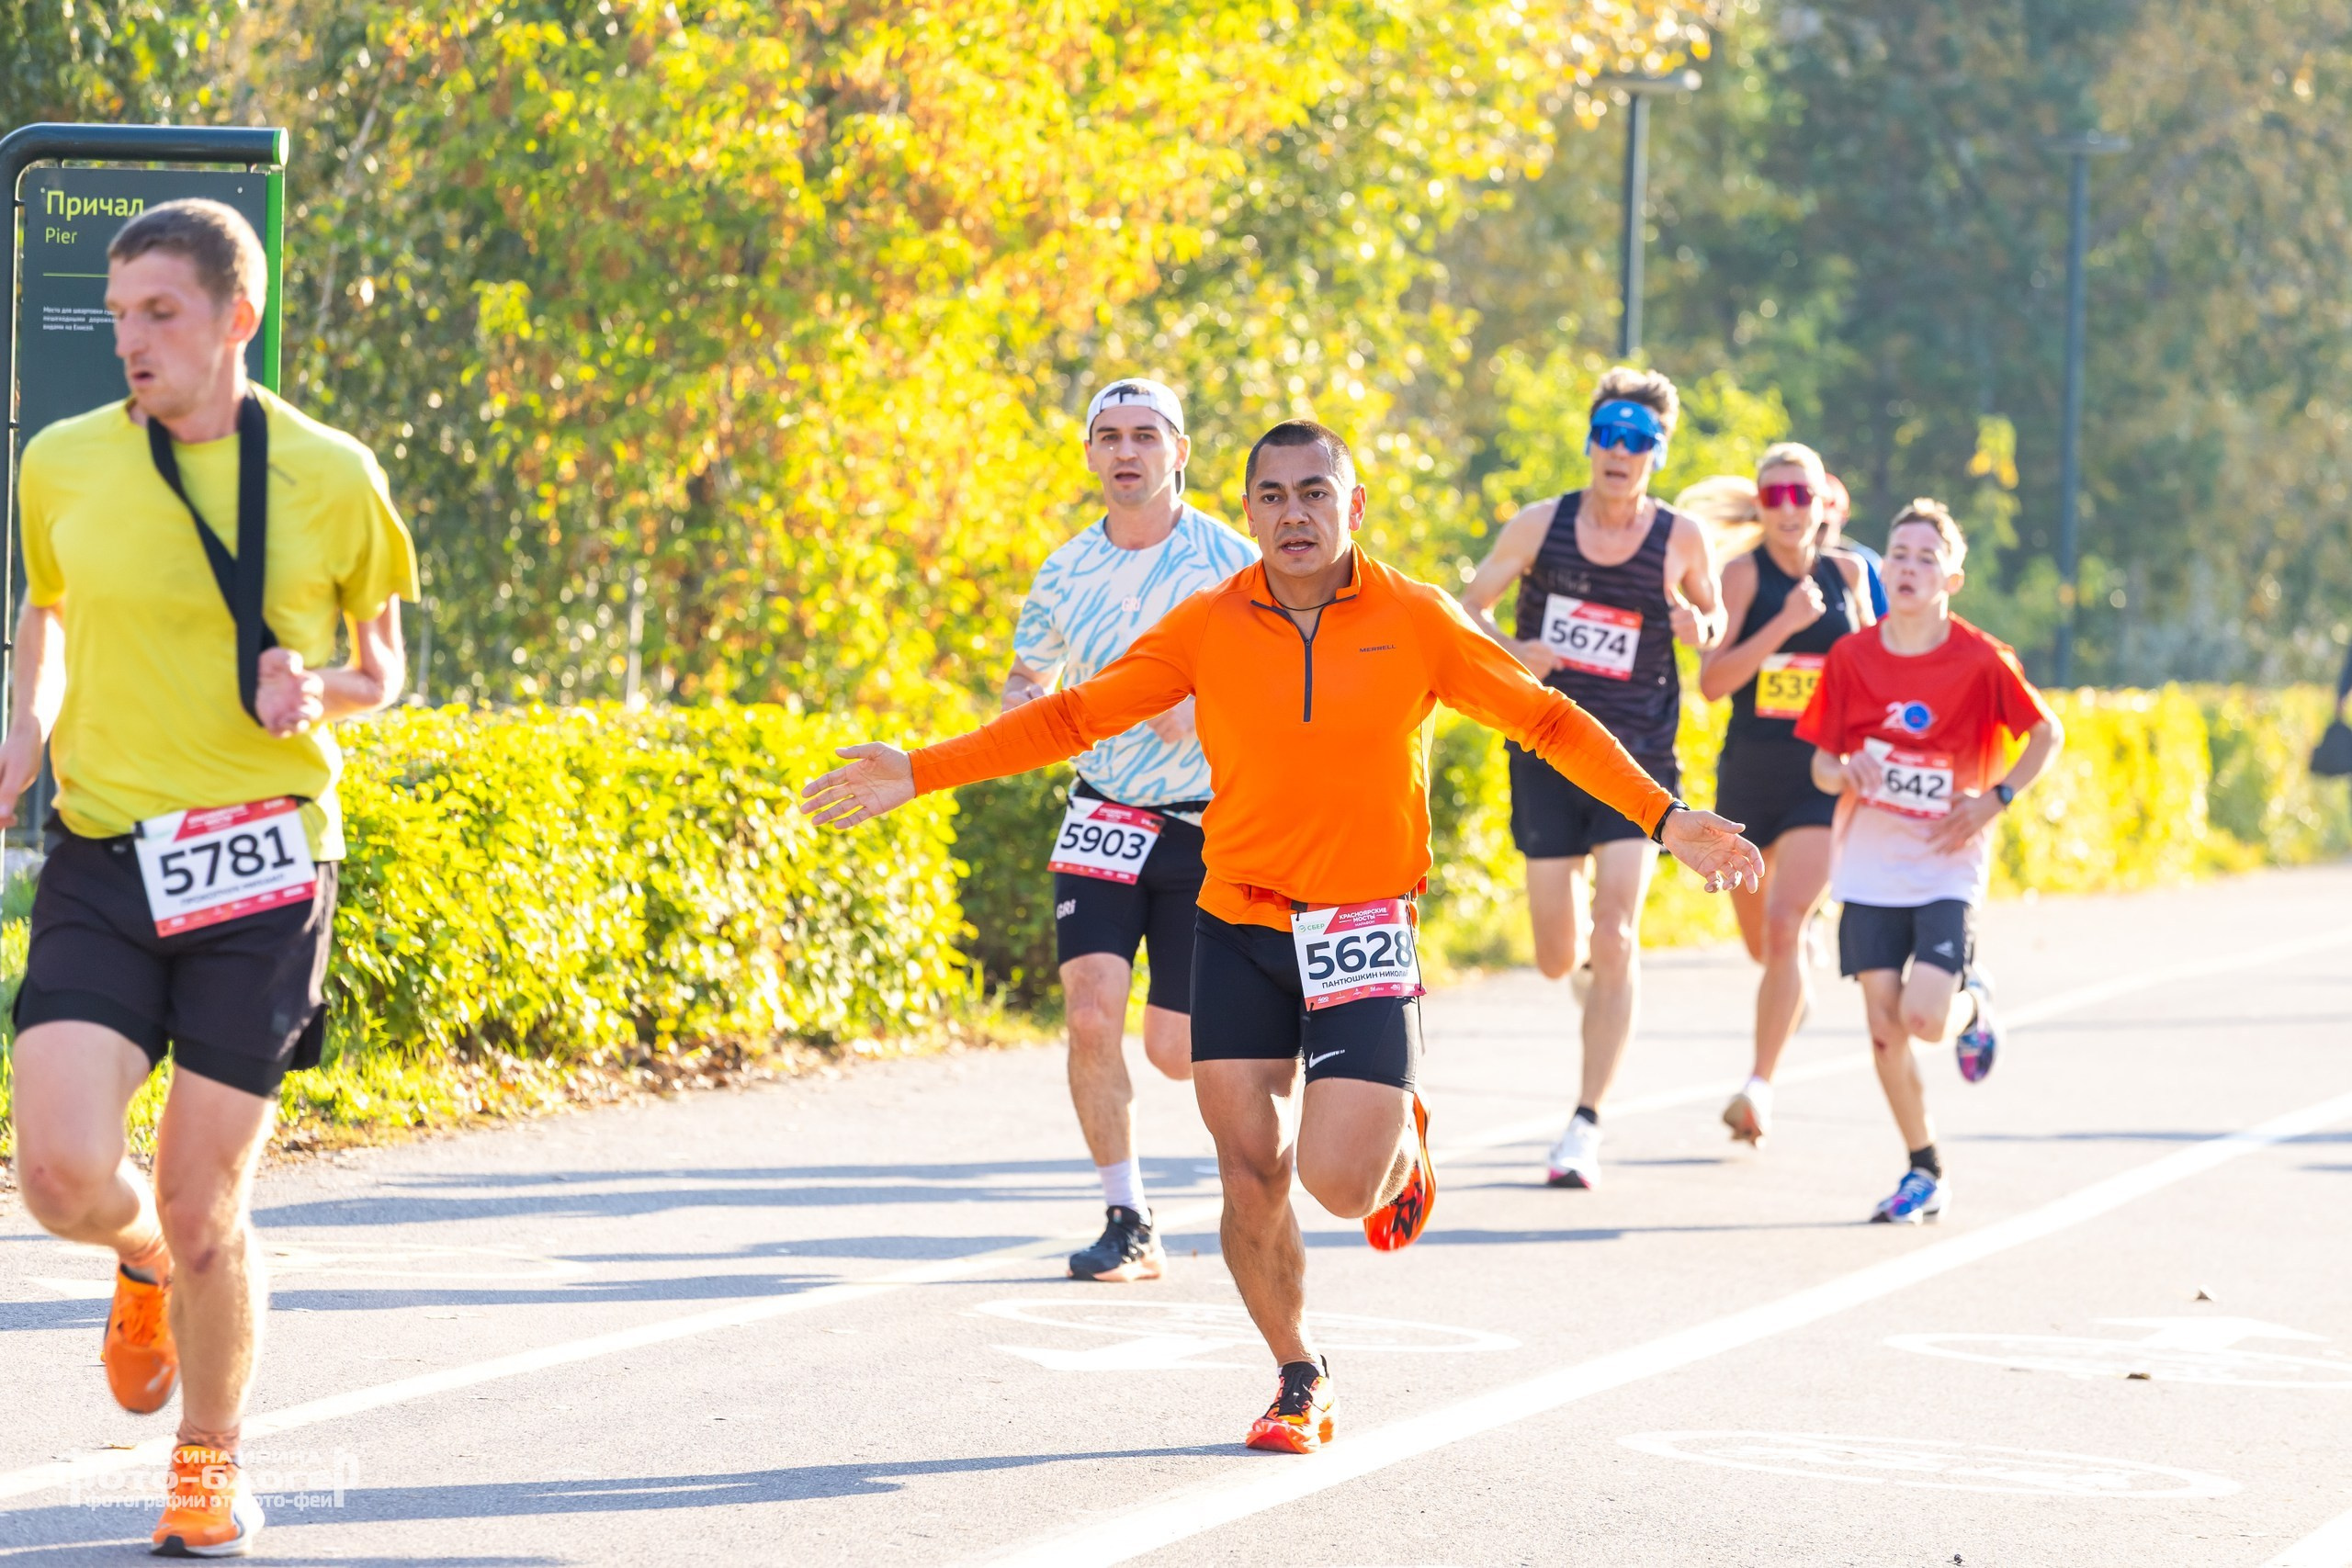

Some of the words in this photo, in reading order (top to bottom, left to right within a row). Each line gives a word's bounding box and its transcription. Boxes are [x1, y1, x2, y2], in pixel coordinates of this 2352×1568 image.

[46, 190, 144, 221] Причал
[45, 227, 78, 244] Pier
[1360, 644, 1396, 653] MERRELL
[1550, 619, 1627, 657] 5674
[1885, 768, 1945, 800] 642
[1060, 823, 1147, 860] 5903
[160, 825, 294, 897] 5781
[1339, 908, 1387, 920] КРАСНОЯРСКИЕ
[1352, 914, 1375, 922] МОСТЫ
[1306, 931, 1413, 981] 5628
[1322, 972, 1378, 988] ПАНТЮШКИН
